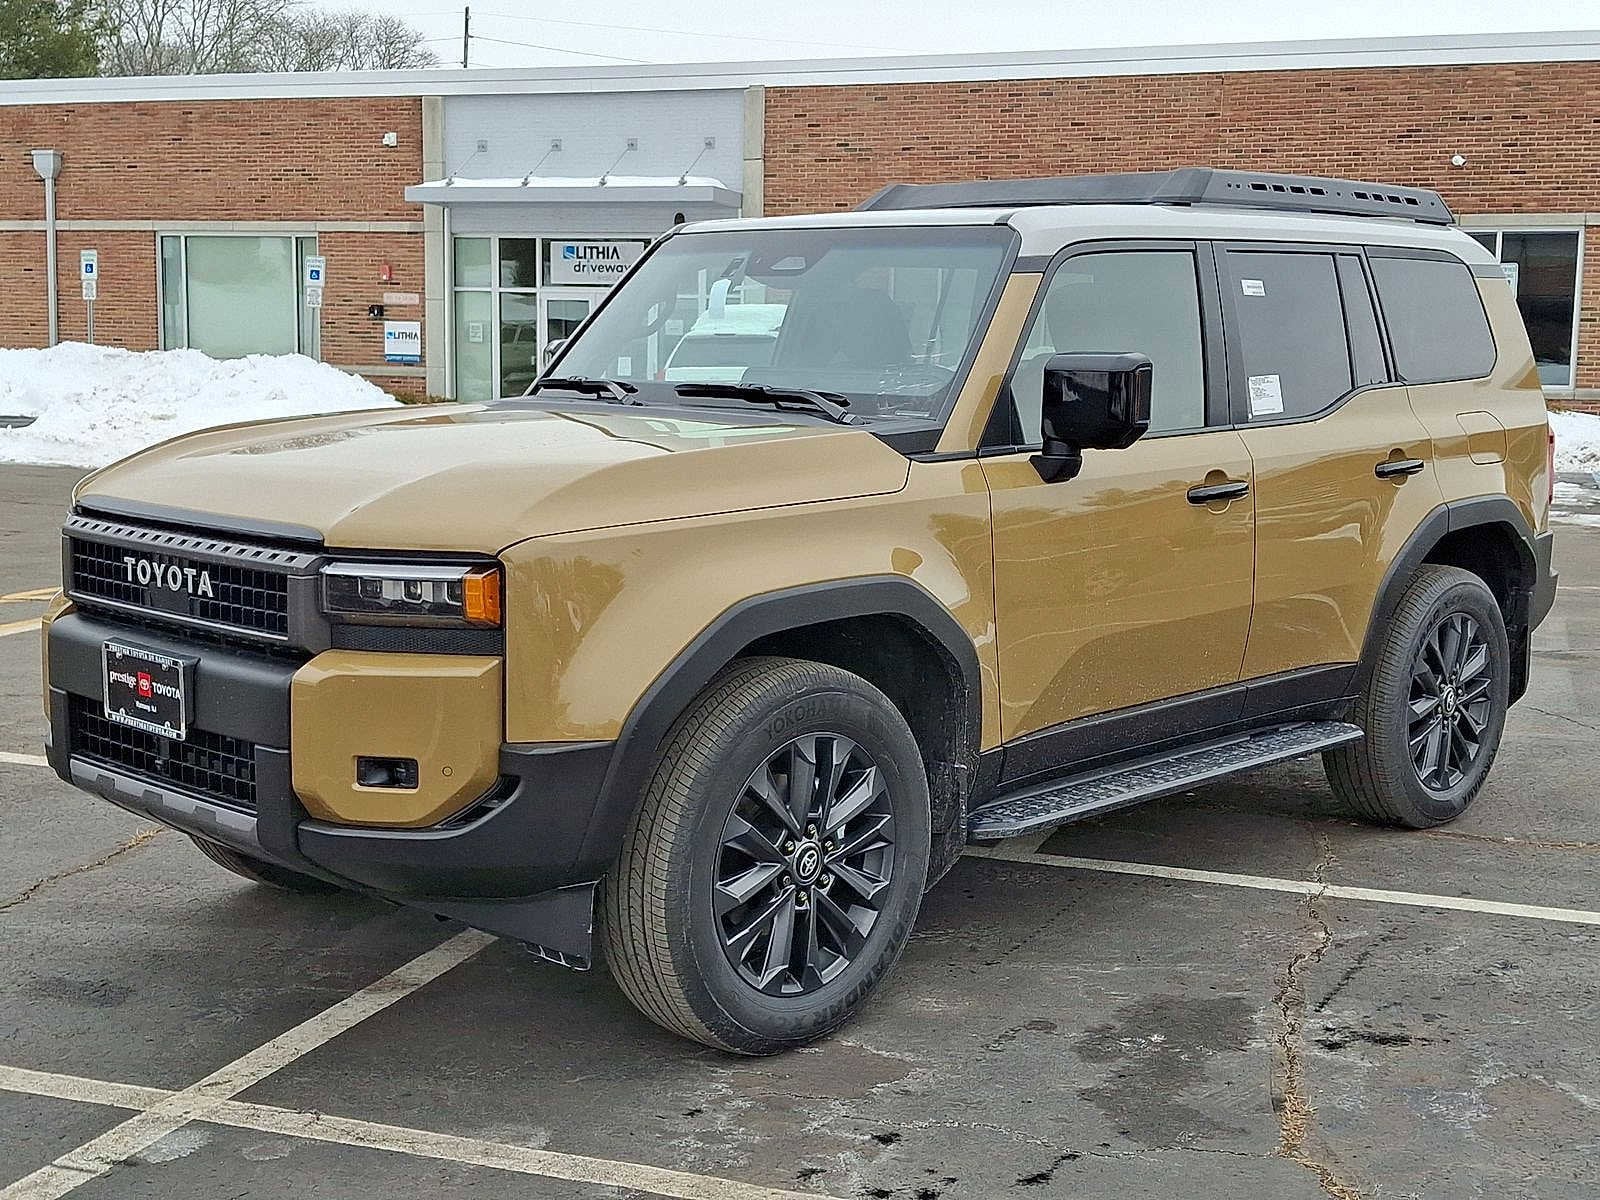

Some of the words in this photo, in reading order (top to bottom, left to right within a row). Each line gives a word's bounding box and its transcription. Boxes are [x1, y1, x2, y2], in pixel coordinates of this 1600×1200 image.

[576, 246, 620, 260] LITHIA
[393, 331, 419, 340] LITHIA
[123, 556, 214, 598] TOYOTA
[109, 671, 137, 688] prestige
[152, 682, 181, 700] TOYOTA
